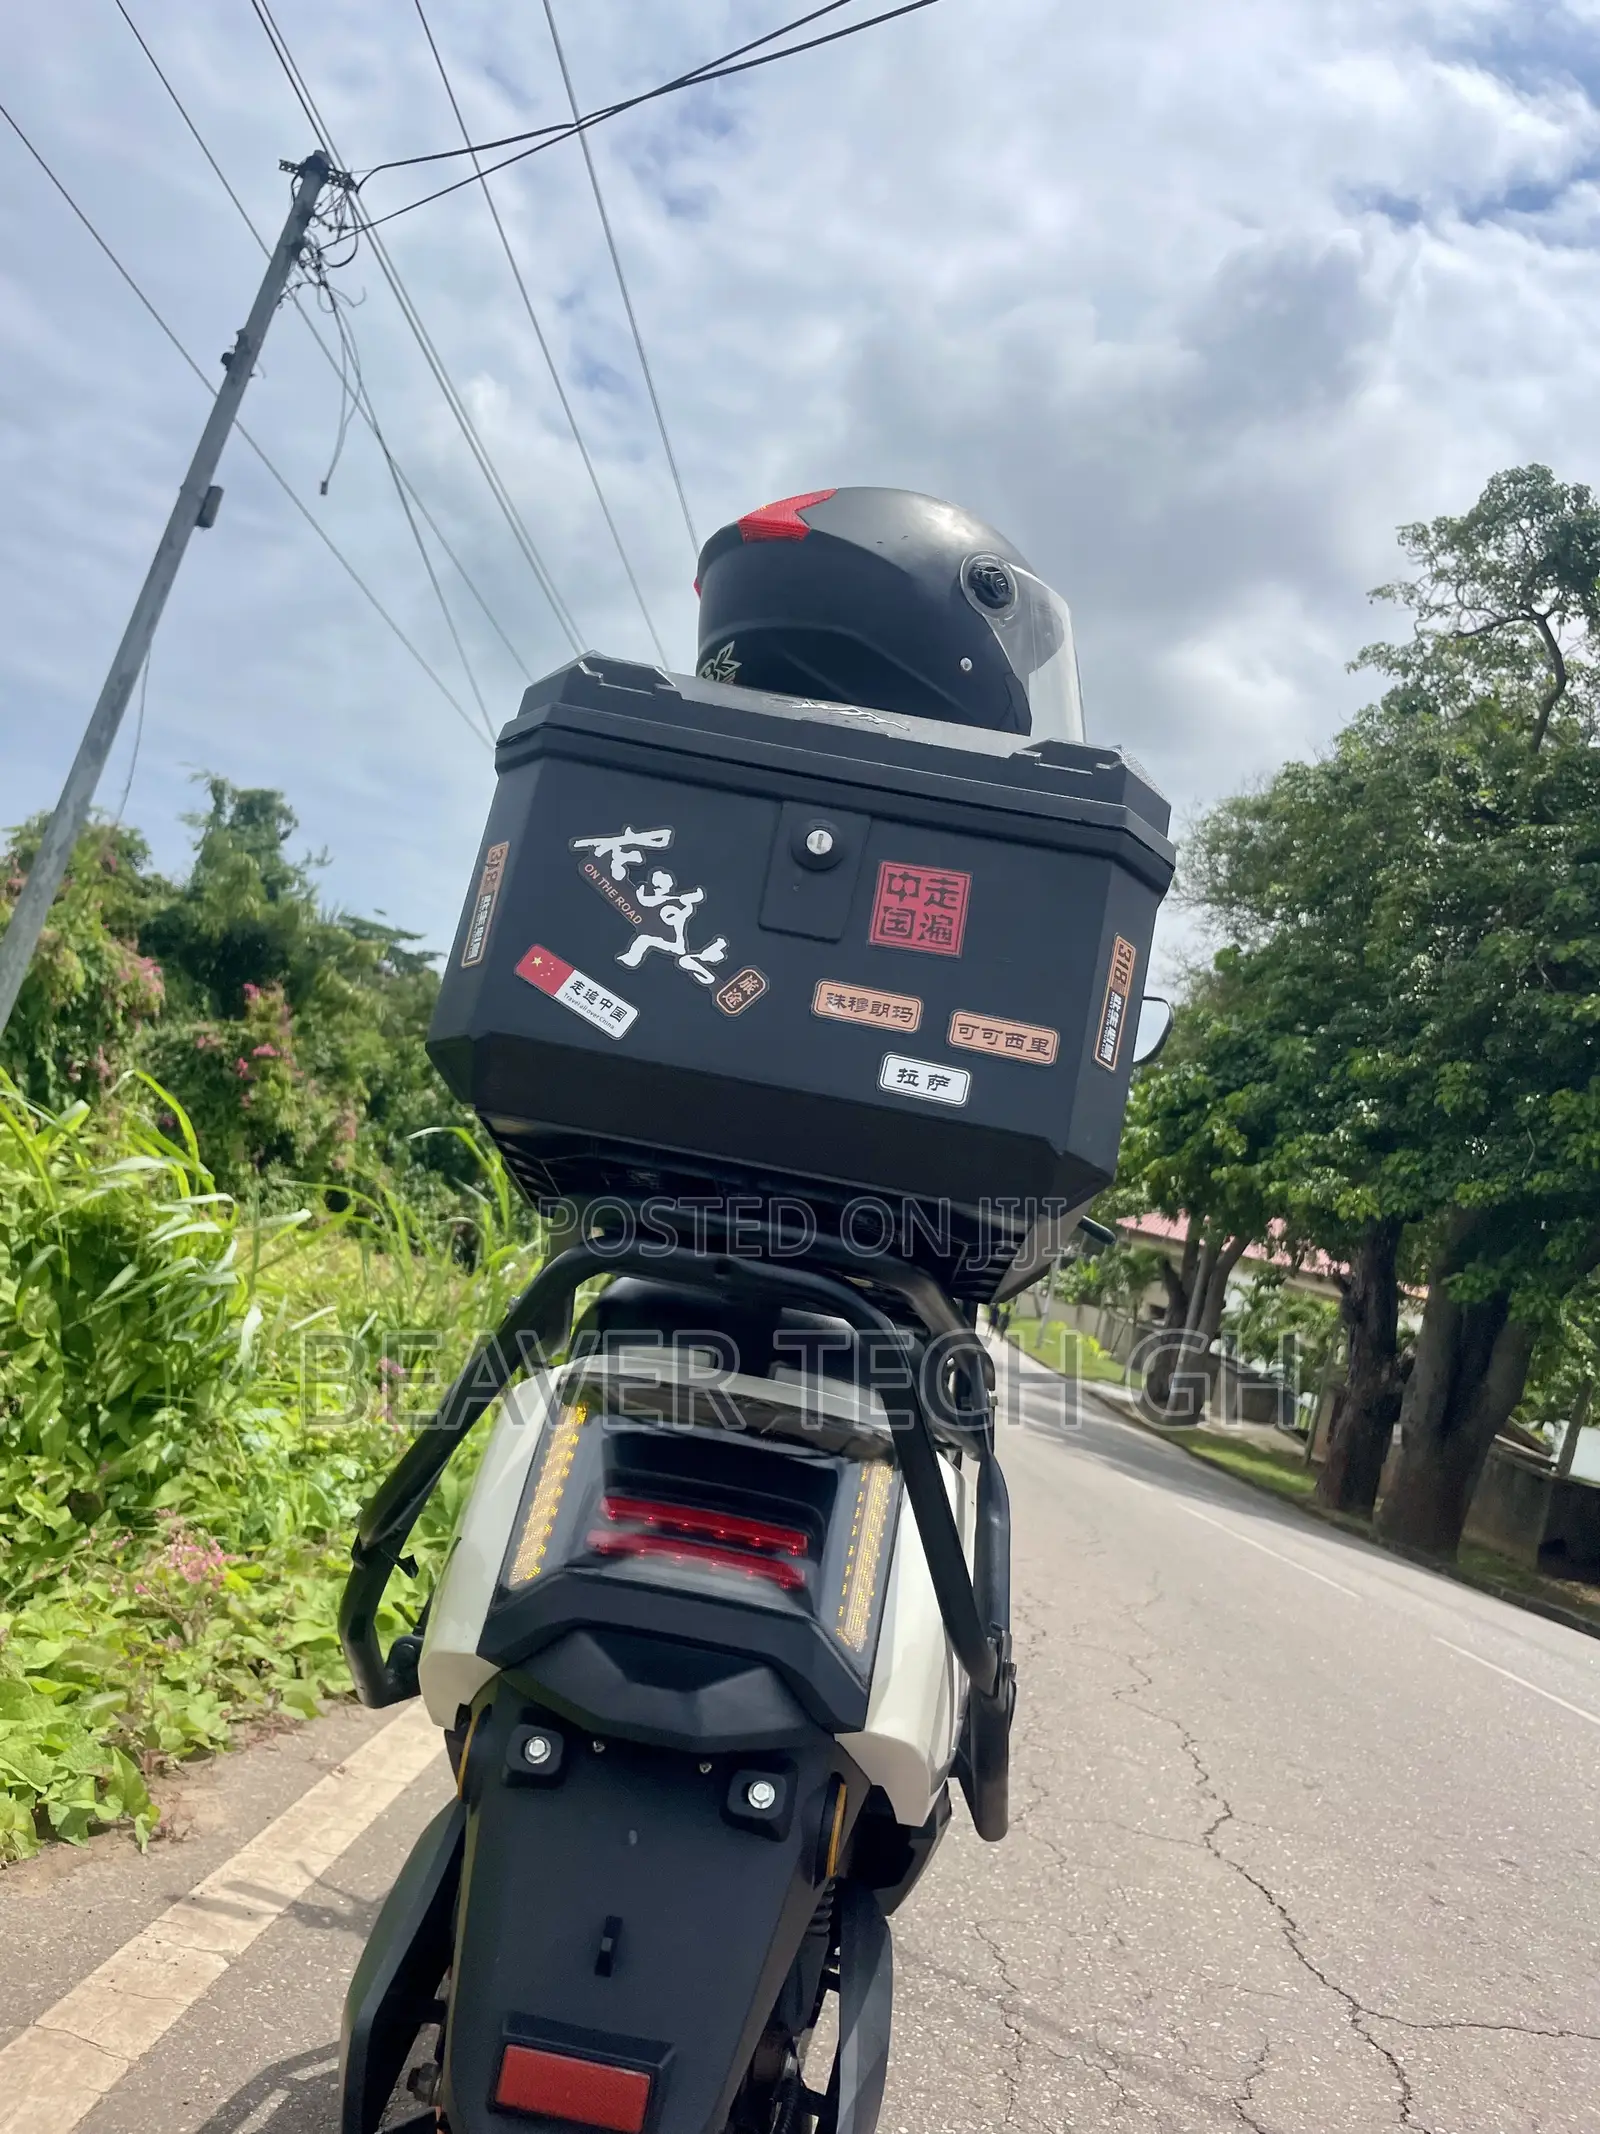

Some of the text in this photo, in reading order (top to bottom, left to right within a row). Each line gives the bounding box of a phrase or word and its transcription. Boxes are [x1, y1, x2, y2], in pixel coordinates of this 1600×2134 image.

[584, 864, 643, 924] ON THE ROAD
[1113, 942, 1131, 986] 318
[564, 992, 580, 1006] Travel
[587, 1009, 600, 1019] over
[599, 1016, 615, 1030] China
[569, 980, 628, 1024] 走遍中国
[826, 992, 914, 1024] 珠穆朗玛
[957, 1022, 1051, 1057] 可可西里
[896, 1068, 952, 1092] 拉萨
